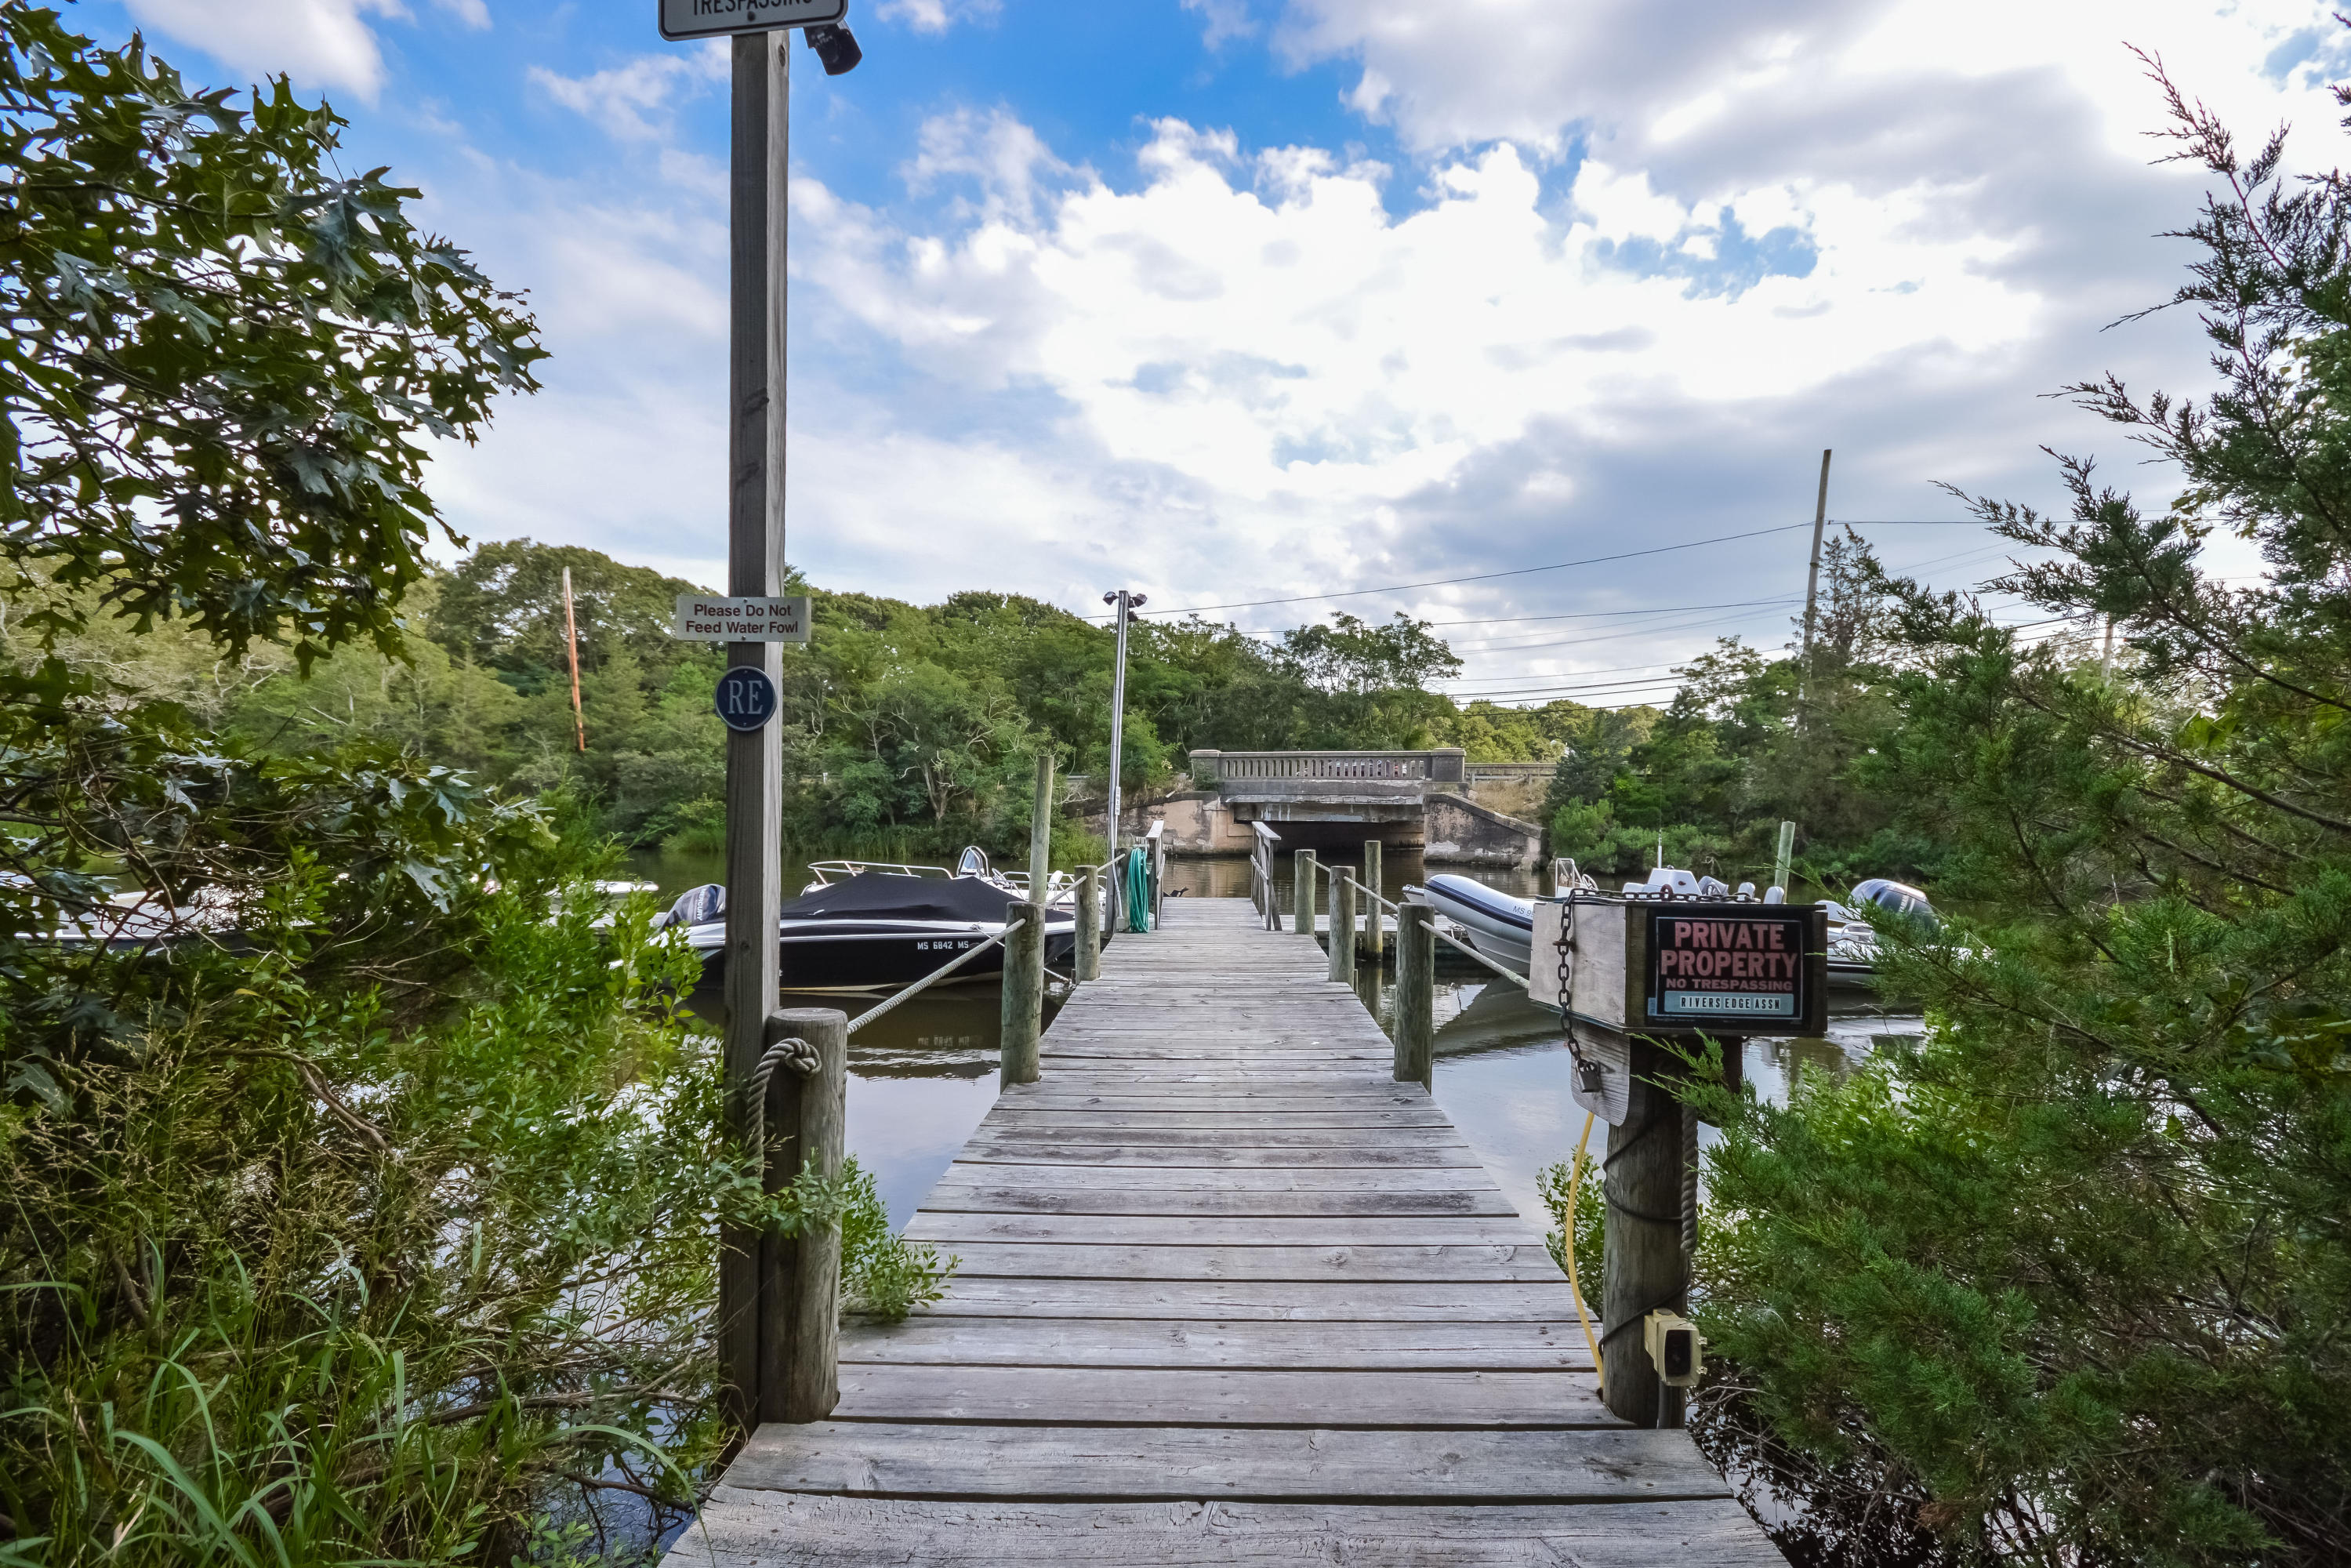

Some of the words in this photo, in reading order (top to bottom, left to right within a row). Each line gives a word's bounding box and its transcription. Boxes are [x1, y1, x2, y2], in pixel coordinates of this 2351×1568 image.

[693, 0, 812, 16] TRESPA
[694, 604, 741, 616] Please
[746, 604, 764, 616] Do
[769, 604, 791, 616] Not
[686, 620, 721, 633] Feed
[726, 622, 764, 633] Water
[769, 621, 798, 633] Fowl
[727, 680, 764, 714] RE
[696, 888, 706, 921] MERCURY
[1513, 906, 1525, 914] MS
[1674, 921, 1785, 949] PRIVATE
[933, 941, 952, 949] 6842
[1660, 949, 1798, 978] PROPERTY
[1666, 978, 1687, 989] NO
[1692, 978, 1793, 991] TRESPASSING
[1681, 996, 1721, 1008] RIVERS
[1725, 998, 1751, 1009] EDGE
[1754, 999, 1780, 1010] ASSN
